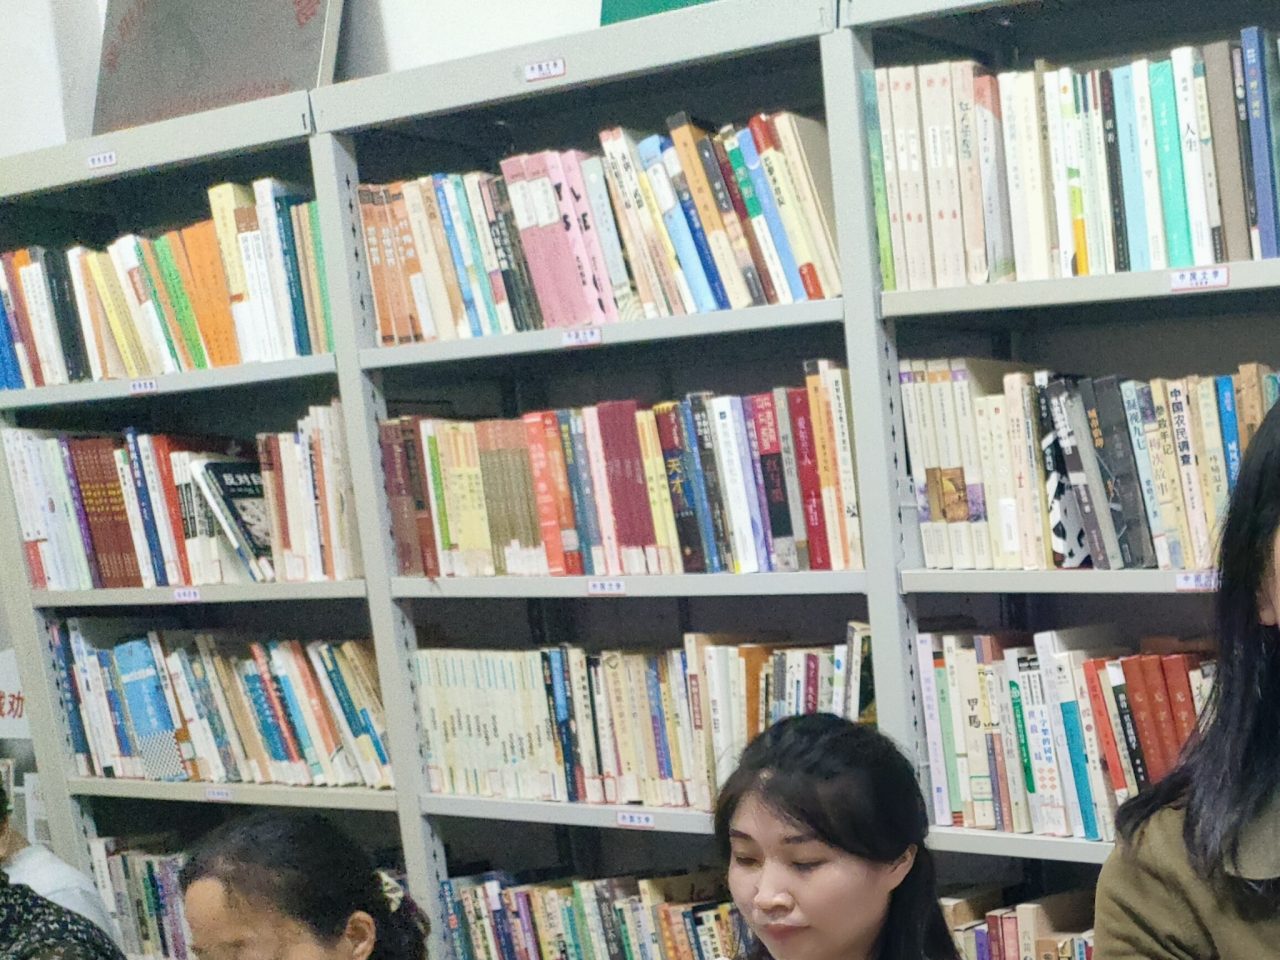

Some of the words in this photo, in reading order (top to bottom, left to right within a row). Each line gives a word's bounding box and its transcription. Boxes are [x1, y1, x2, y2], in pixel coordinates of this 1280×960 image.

[1183, 123, 1197, 153] 人生
[1169, 388, 1192, 466] 中国农民调查
